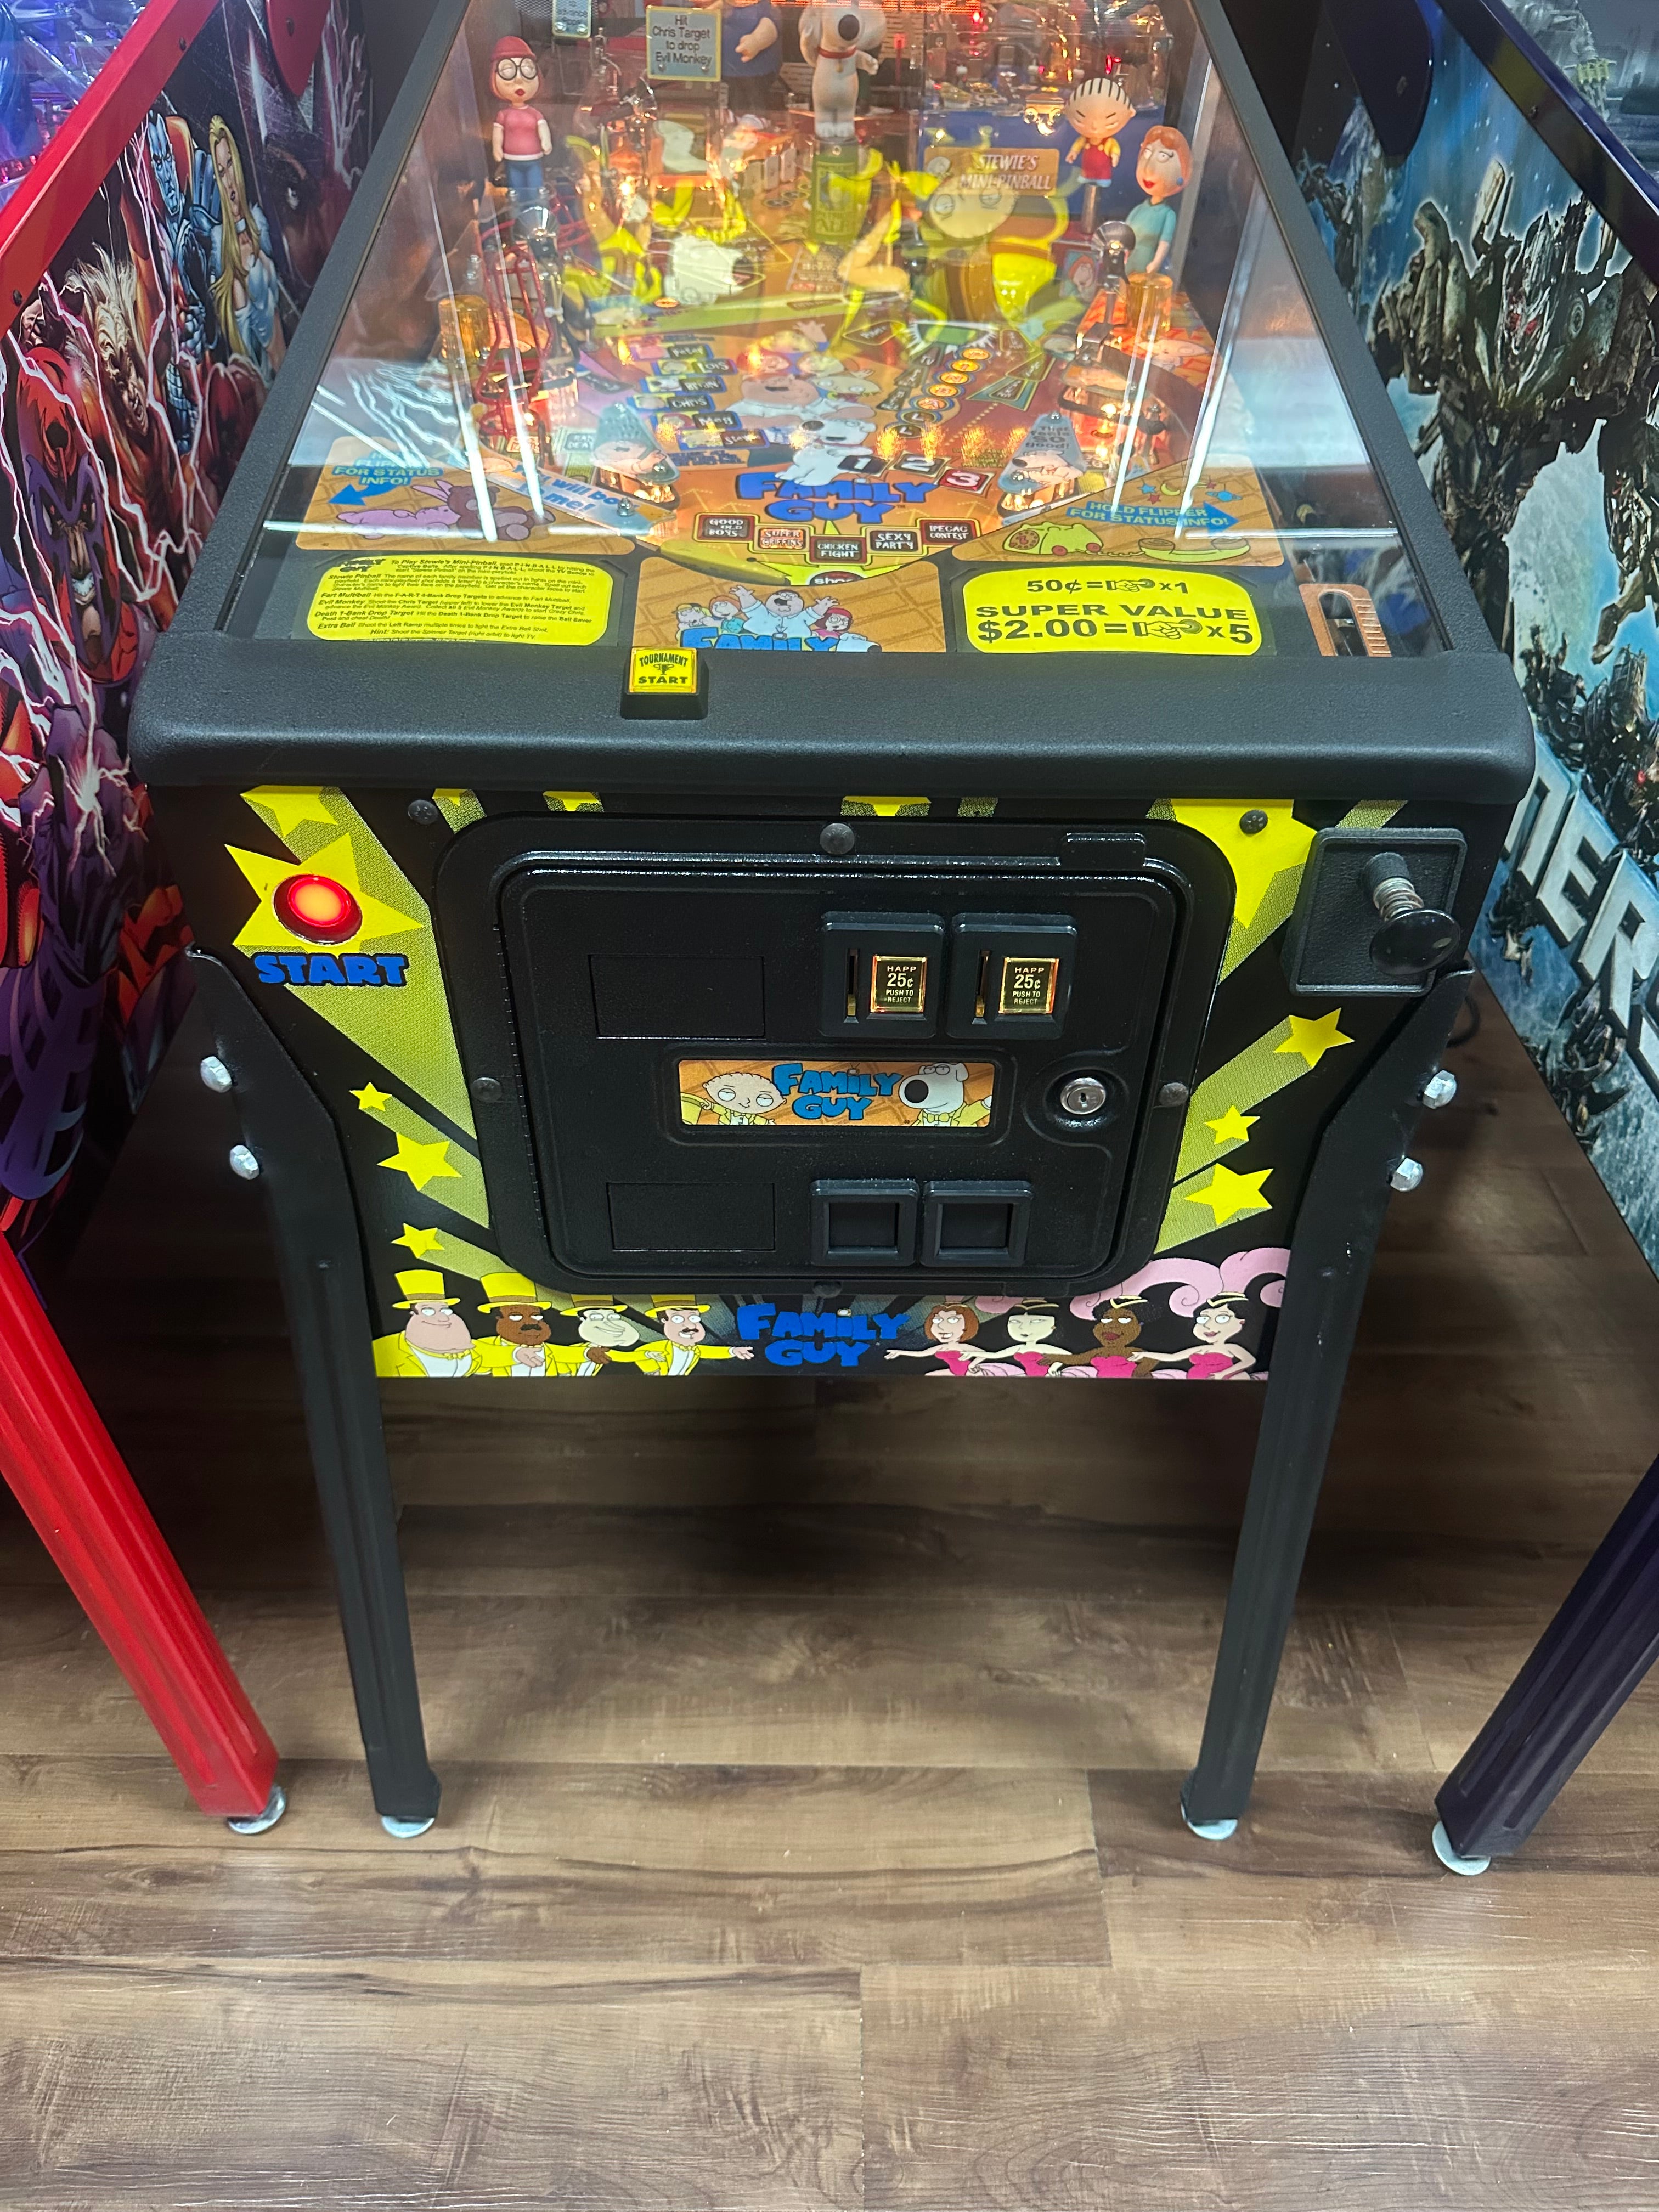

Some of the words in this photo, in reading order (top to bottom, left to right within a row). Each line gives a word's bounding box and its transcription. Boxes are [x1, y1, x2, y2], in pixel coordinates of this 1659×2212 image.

[675, 15, 687, 25] Hit
[653, 26, 675, 37] Chris
[679, 27, 710, 41] Target
[666, 41, 675, 50] to
[677, 41, 701, 53] drop
[655, 52, 671, 62] Evil
[673, 53, 712, 66] Monkey
[974, 154, 1040, 170] STEWIE'S
[334, 467, 369, 476] FOR
[373, 468, 440, 476] STATUS
[361, 477, 409, 485] INFO!
[946, 472, 981, 486] 3
[552, 478, 592, 495] will
[736, 472, 940, 503] FAMILY
[764, 500, 898, 524] GUY
[1090, 502, 1135, 514] HOD
[709, 518, 744, 527] GOOD
[1069, 509, 1105, 520] FOR
[1110, 512, 1178, 526] STATUS
[1182, 517, 1229, 526] INFO!
[708, 529, 738, 538] BOYS
[763, 529, 800, 538] SUPER
[929, 524, 968, 532] IPECAC
[877, 533, 912, 542] SEXY
[929, 531, 970, 540] CONTEST
[761, 538, 804, 548] GRIFFINS
[817, 542, 859, 551] CHICKEN
[875, 540, 915, 550] PARTY
[820, 550, 857, 558] FIGHT
[975, 603, 1107, 619] SUPER
[1120, 603, 1250, 622] VALUE
[1207, 622, 1254, 644] x5
[639, 653, 689, 667] TOURNAMENT
[638, 676, 688, 685] START
[255, 954, 408, 985] START
[887, 973, 914, 988] 25¢
[1014, 974, 1041, 989] 25¢
[771, 1063, 905, 1097] FAMILY
[792, 1094, 872, 1120] GUY
[737, 1303, 911, 1340] FAMILY
[764, 1341, 871, 1367] GUY
